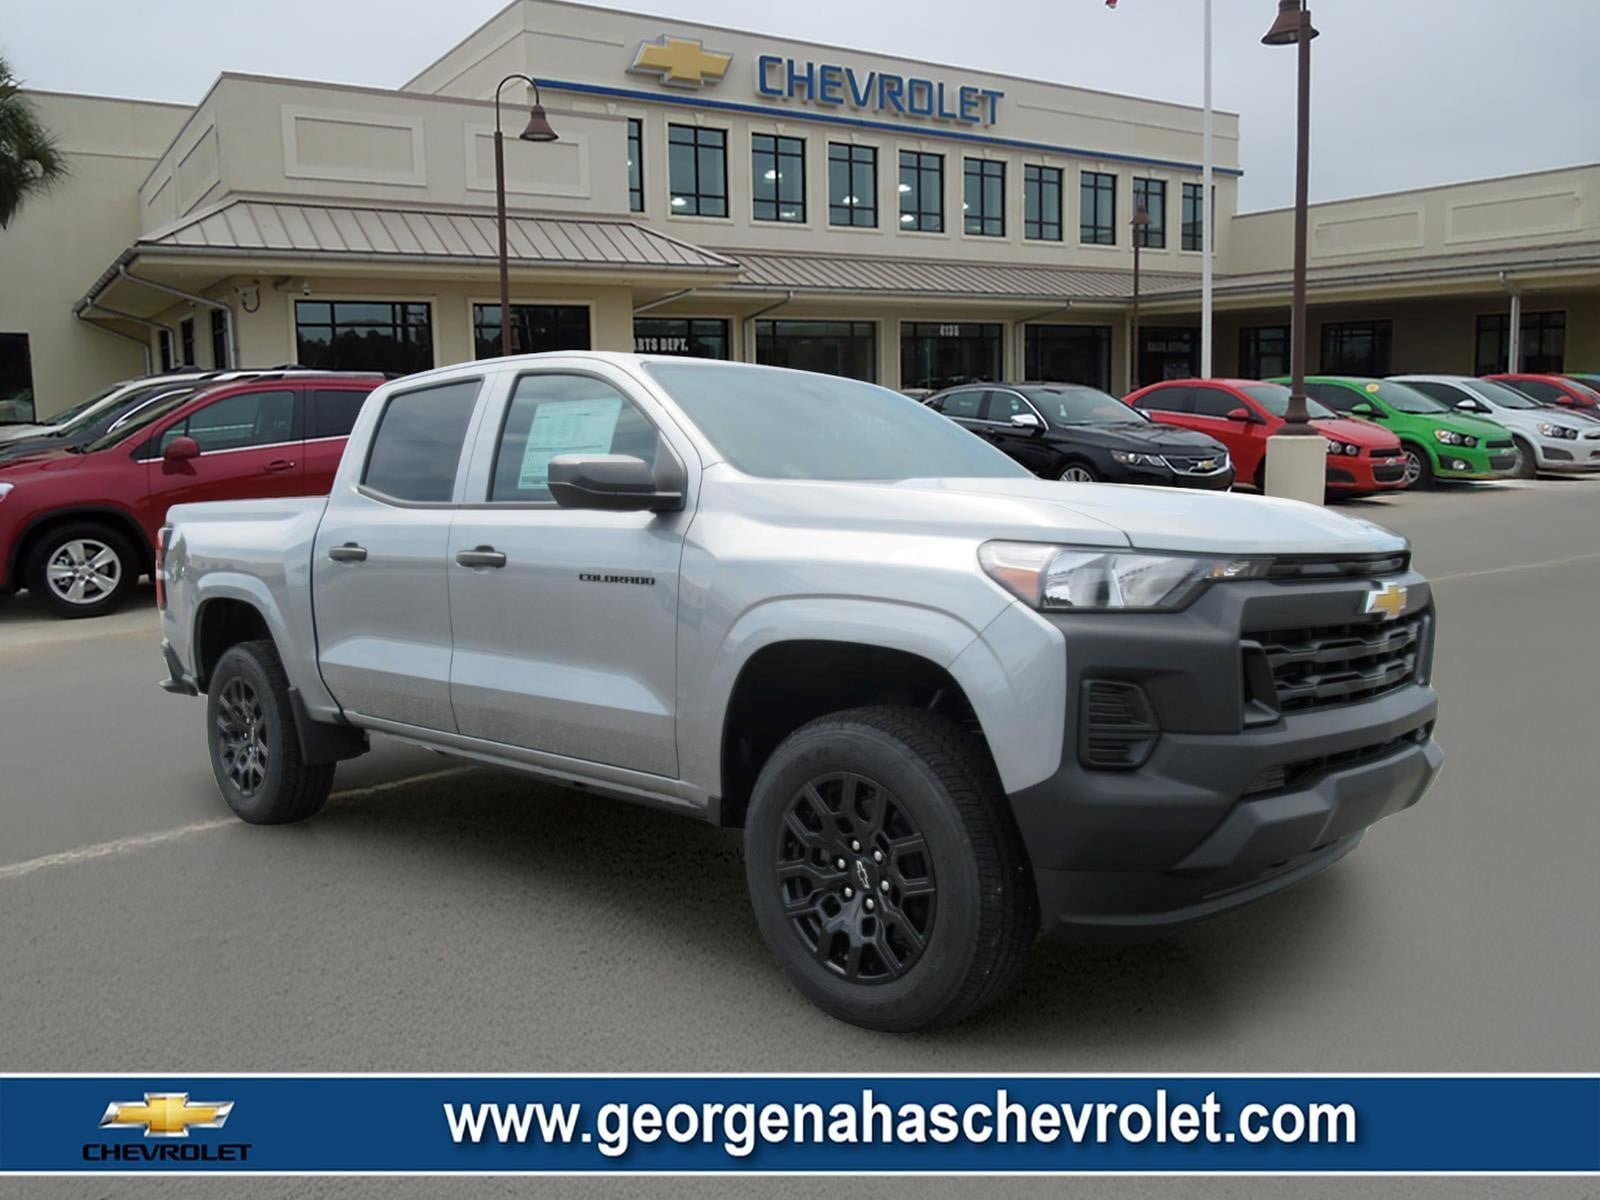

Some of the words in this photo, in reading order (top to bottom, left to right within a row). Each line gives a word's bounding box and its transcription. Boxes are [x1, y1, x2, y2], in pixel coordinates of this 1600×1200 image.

[756, 54, 1005, 126] CHEVROLET
[634, 337, 658, 351] RTS
[660, 338, 689, 351] DEPT.
[578, 573, 656, 586] COLORADO
